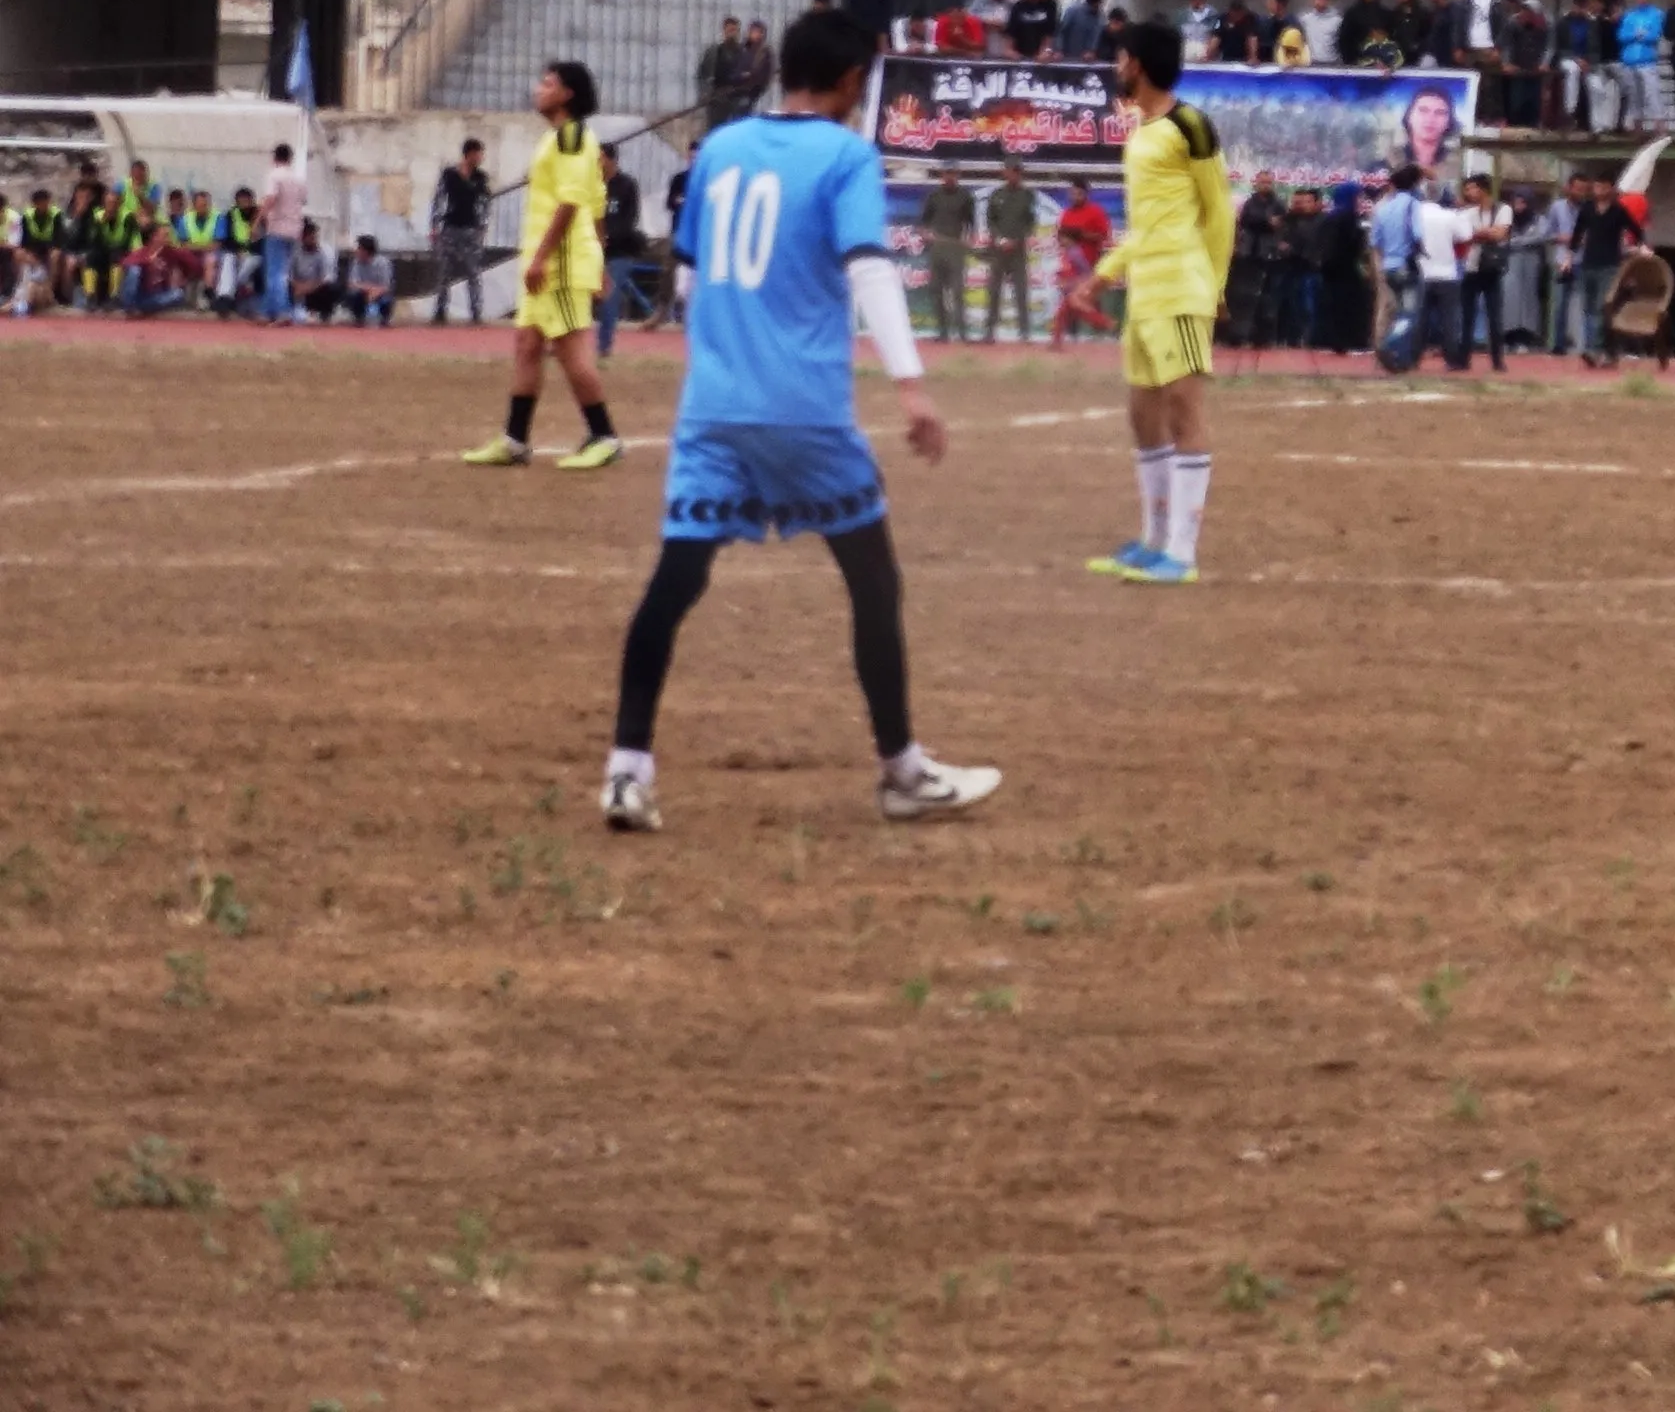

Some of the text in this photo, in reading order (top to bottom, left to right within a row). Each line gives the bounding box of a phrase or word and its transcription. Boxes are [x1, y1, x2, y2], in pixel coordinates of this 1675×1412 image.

[934, 66, 1107, 110] شبيبة الرقة
[883, 105, 977, 151] عفرين
[705, 164, 780, 290] 10
